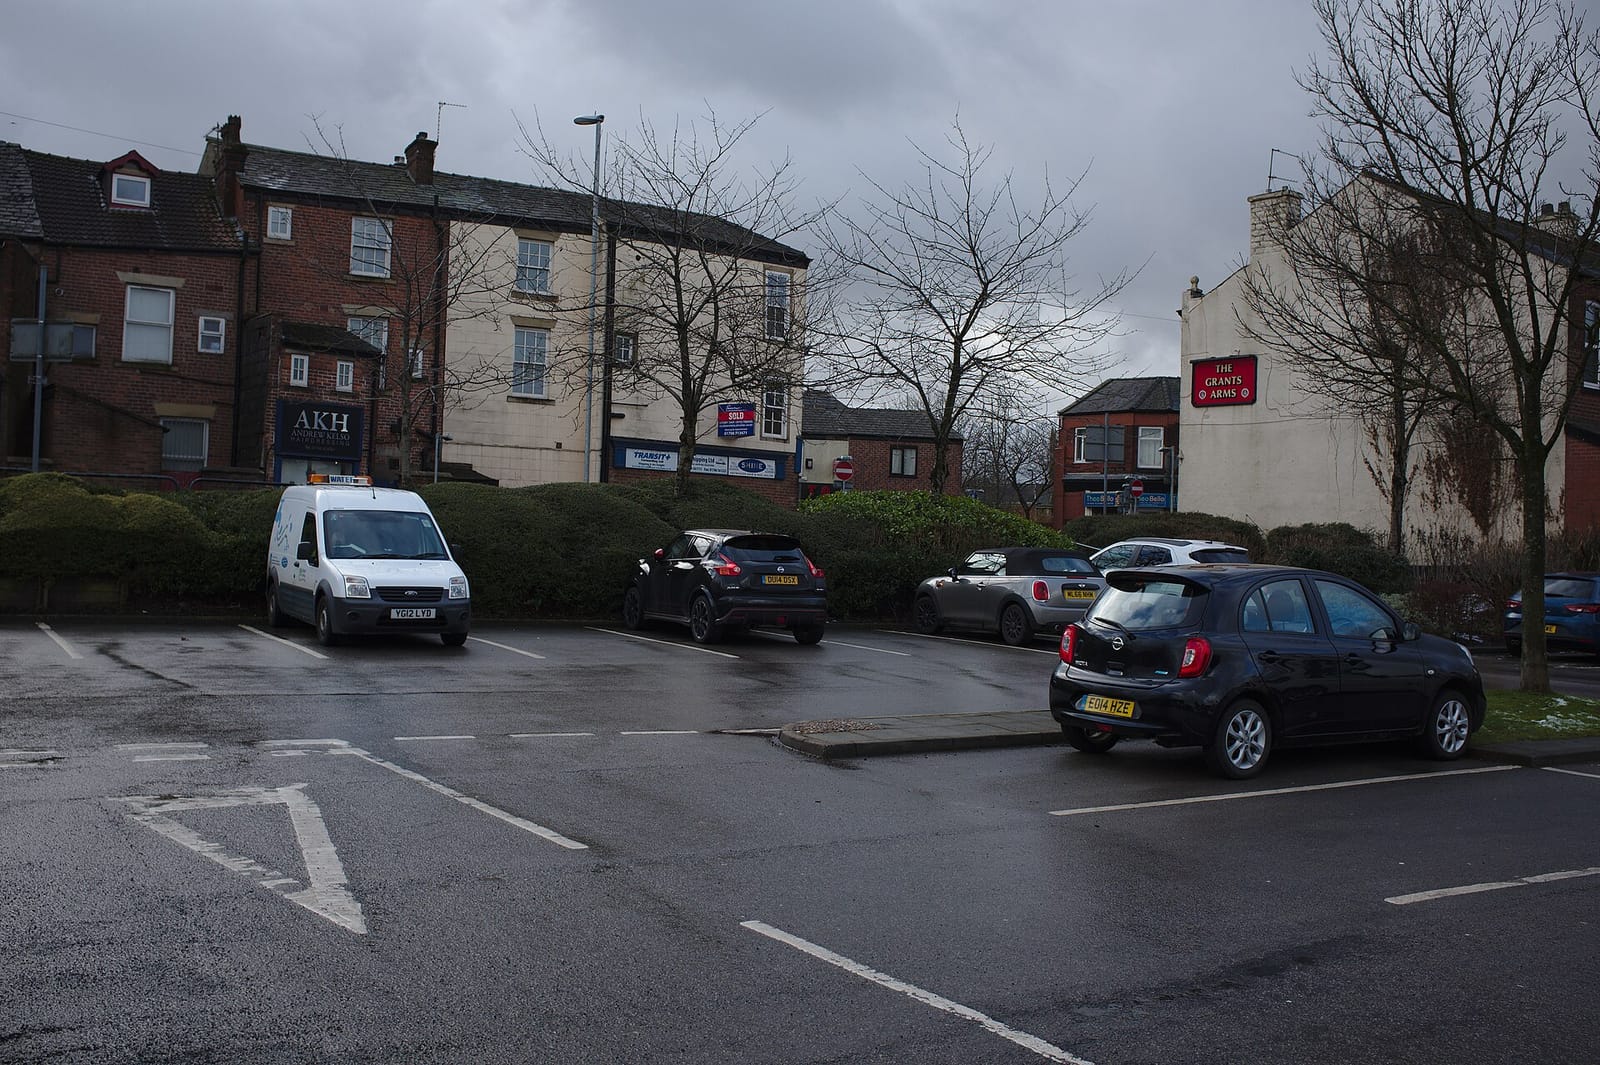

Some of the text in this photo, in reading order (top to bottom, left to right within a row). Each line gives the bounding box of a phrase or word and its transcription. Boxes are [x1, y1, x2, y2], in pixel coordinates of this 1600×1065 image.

[1215, 363, 1233, 373] THE
[1205, 375, 1242, 387] GRANTS
[1210, 388, 1237, 399] ARMS
[293, 409, 350, 432] AKH
[728, 411, 744, 420] SOLD
[291, 429, 350, 441] ANDREW KELSO
[395, 609, 432, 618] YG12 LYD
[1088, 697, 1131, 714] EO14 HZE
